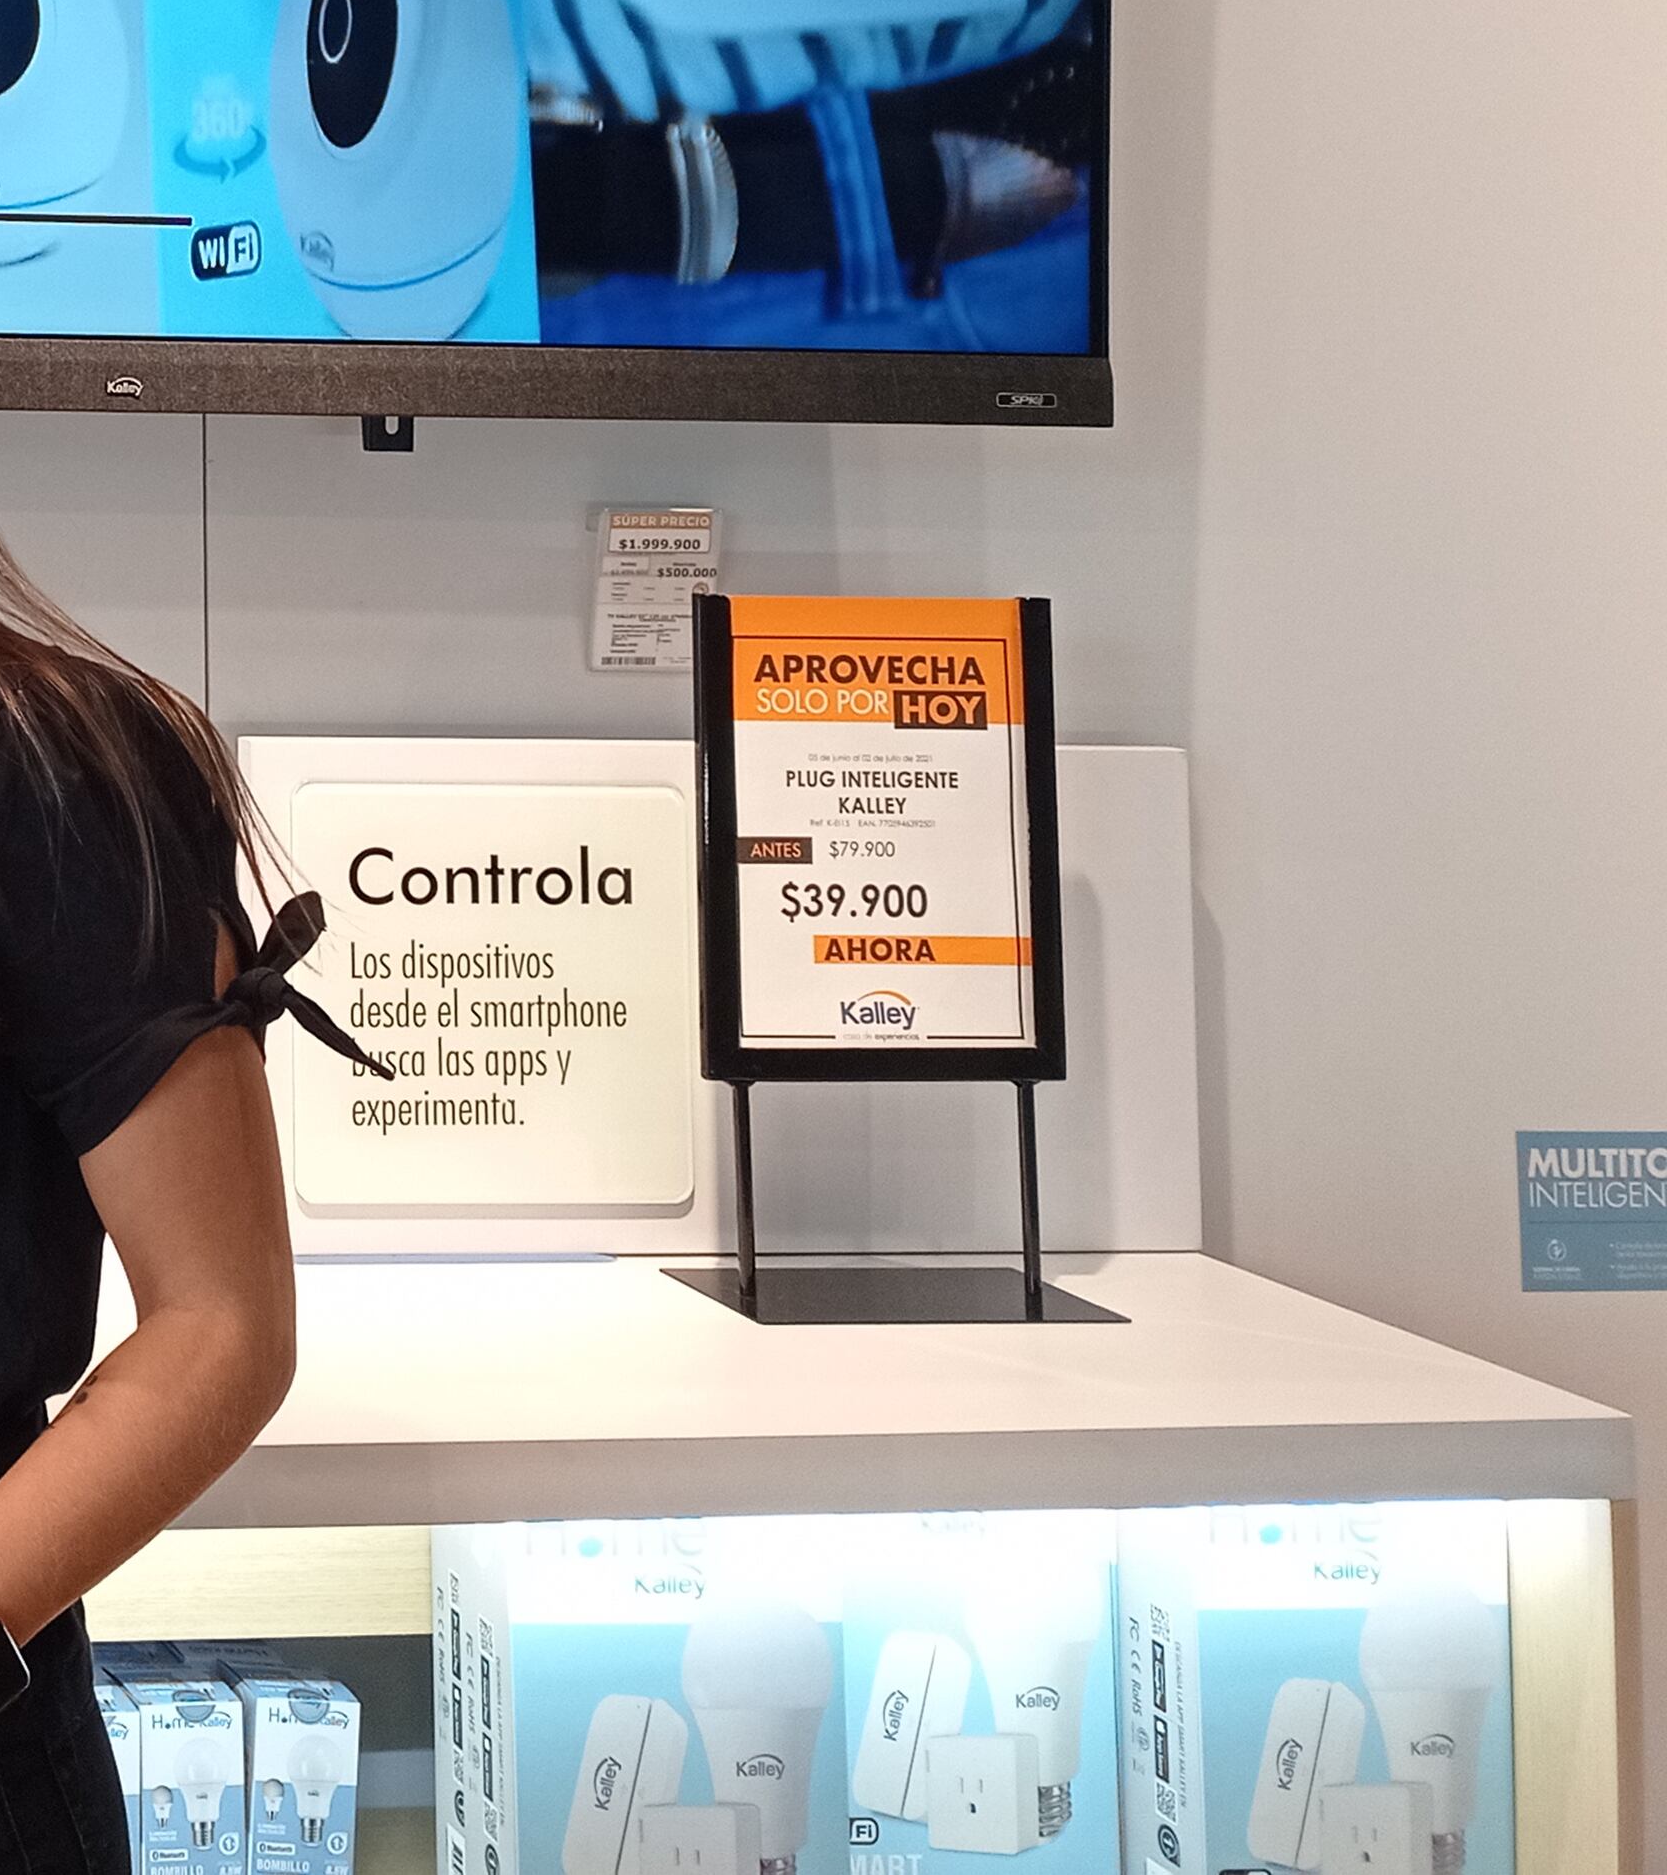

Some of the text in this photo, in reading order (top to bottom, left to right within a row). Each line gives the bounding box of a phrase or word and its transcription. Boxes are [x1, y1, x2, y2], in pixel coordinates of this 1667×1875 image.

[106, 377, 144, 399] Kalley
[660, 516, 710, 527] PRECIO
[619, 538, 701, 551] $1.999.900
[657, 567, 717, 579] $500.000
[753, 654, 986, 686] APROVECHA
[756, 688, 982, 725] SOLO POR HOY
[786, 770, 959, 790] PLUG INTELIGENTE
[838, 796, 907, 815] KALLEY
[750, 840, 896, 859] ANTES $79.900
[348, 845, 634, 906] Controla
[780, 881, 928, 923] $39.900
[350, 939, 555, 989] Los dispositivos
[824, 938, 937, 962] AHORA
[349, 987, 629, 1037] desde el smartphone
[840, 999, 918, 1031] Kalley
[438, 1036, 476, 1077] las
[485, 1049, 548, 1087] apps
[557, 1049, 572, 1086] y
[351, 1090, 526, 1137] experimenta.
[1016, 1689, 1061, 1711] Kalley
[883, 1688, 910, 1743] Kalley
[1410, 1737, 1457, 1757] Kalley
[735, 1757, 787, 1780] Kalley
[1277, 1738, 1304, 1791] Kalley
[593, 1756, 623, 1812] Kalley
[256, 1858, 311, 1873] BOMBILLO
